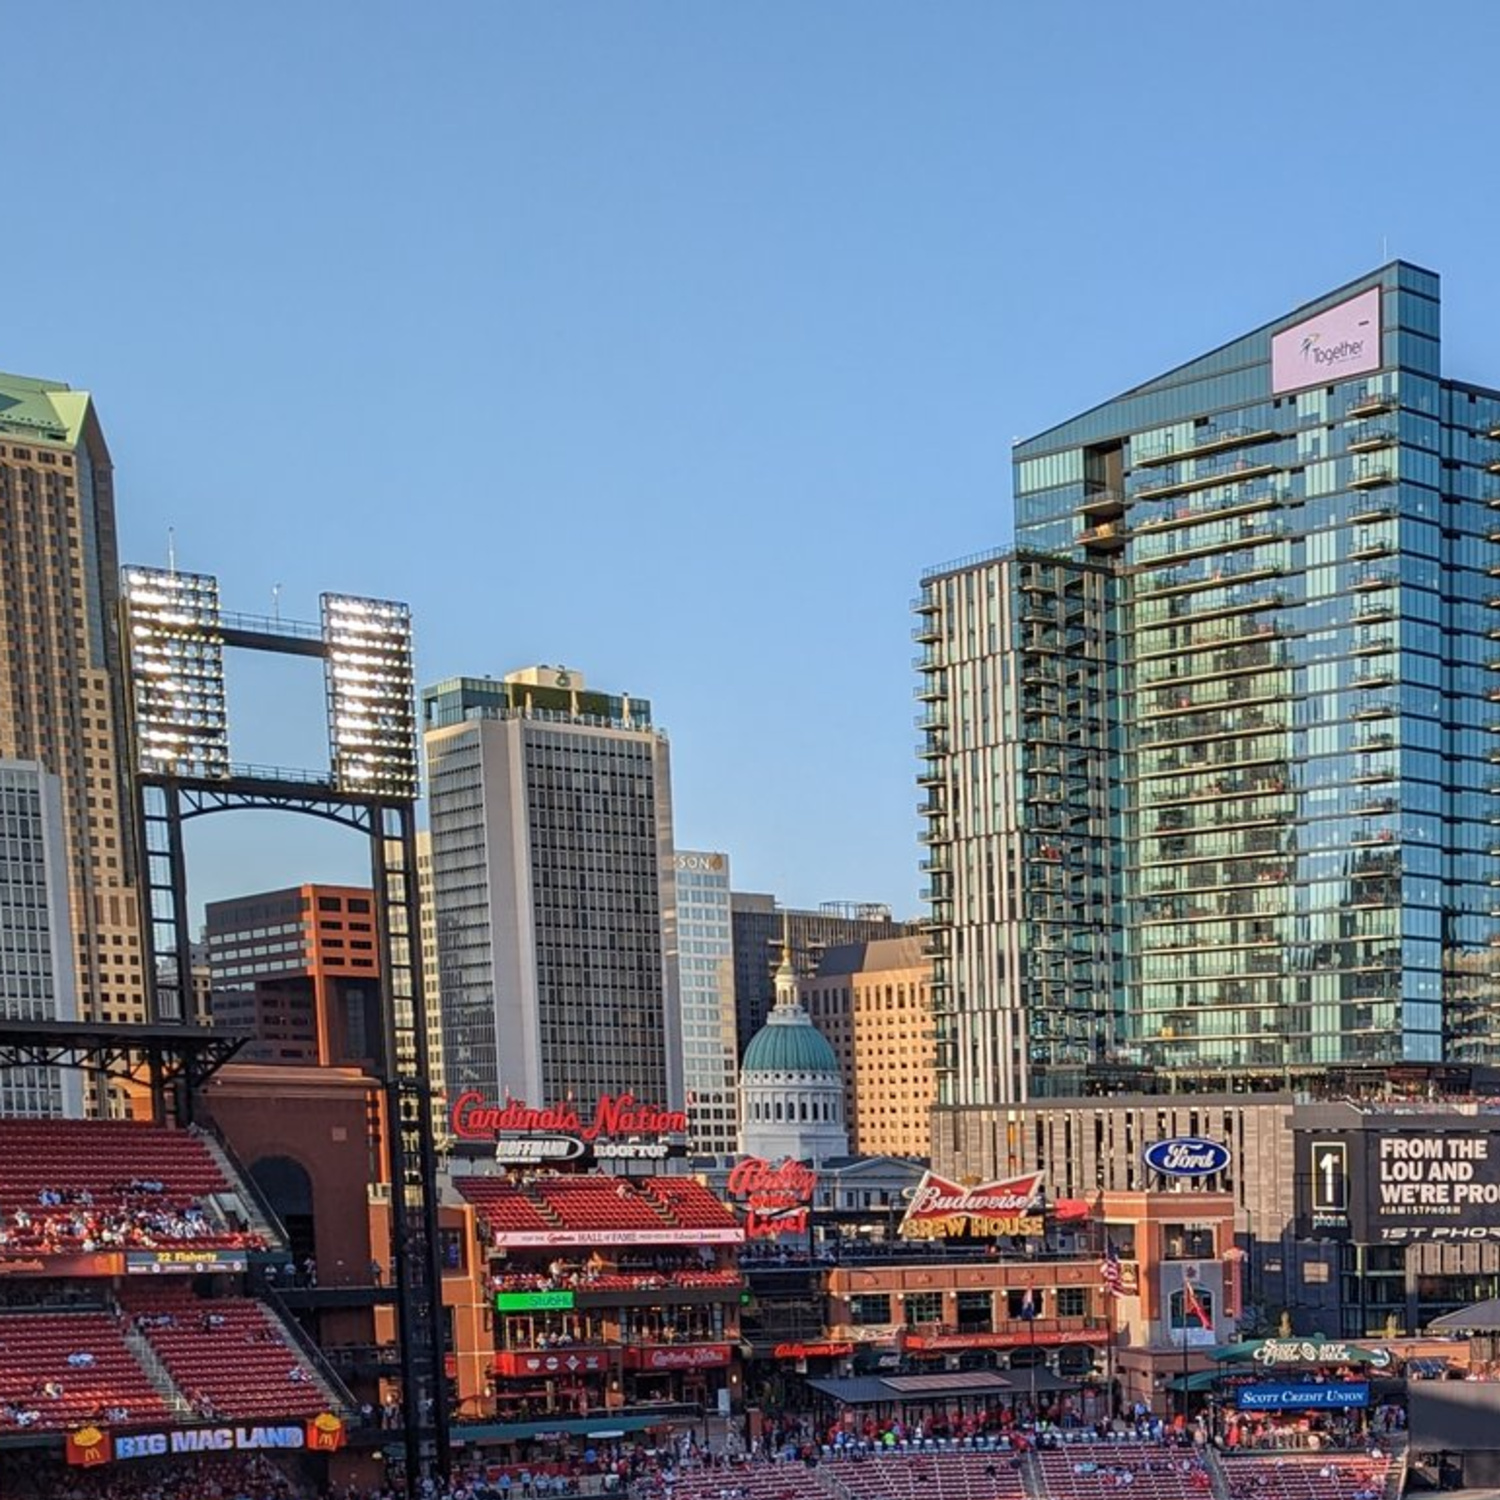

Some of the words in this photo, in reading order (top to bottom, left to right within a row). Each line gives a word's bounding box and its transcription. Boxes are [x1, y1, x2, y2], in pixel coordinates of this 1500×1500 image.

[1314, 339, 1364, 366] Together
[452, 1090, 581, 1138] Cardinals
[581, 1094, 687, 1140] Nation
[593, 1143, 668, 1158] ROOFTOP
[1163, 1143, 1215, 1169] Ford
[1380, 1138, 1443, 1159] FROM
[1447, 1138, 1488, 1159] THE
[1380, 1161, 1424, 1182] LOU
[1427, 1161, 1474, 1182] AND
[901, 1185, 1042, 1213] Budweiser
[1380, 1183, 1449, 1204] WE'RE
[903, 1217, 967, 1238] BREW
[970, 1215, 1045, 1237] HOUSE
[1312, 1213, 1348, 1229] phorm
[1381, 1227, 1427, 1239] 1ST
[1319, 1344, 1346, 1353] MVP
[1241, 1391, 1279, 1404] SCOTT
[1281, 1390, 1324, 1402] CREDIT
[1326, 1389, 1364, 1401] UNION
[115, 1432, 167, 1460] BIG
[171, 1428, 234, 1453] MAC
[239, 1425, 303, 1451] LAND
